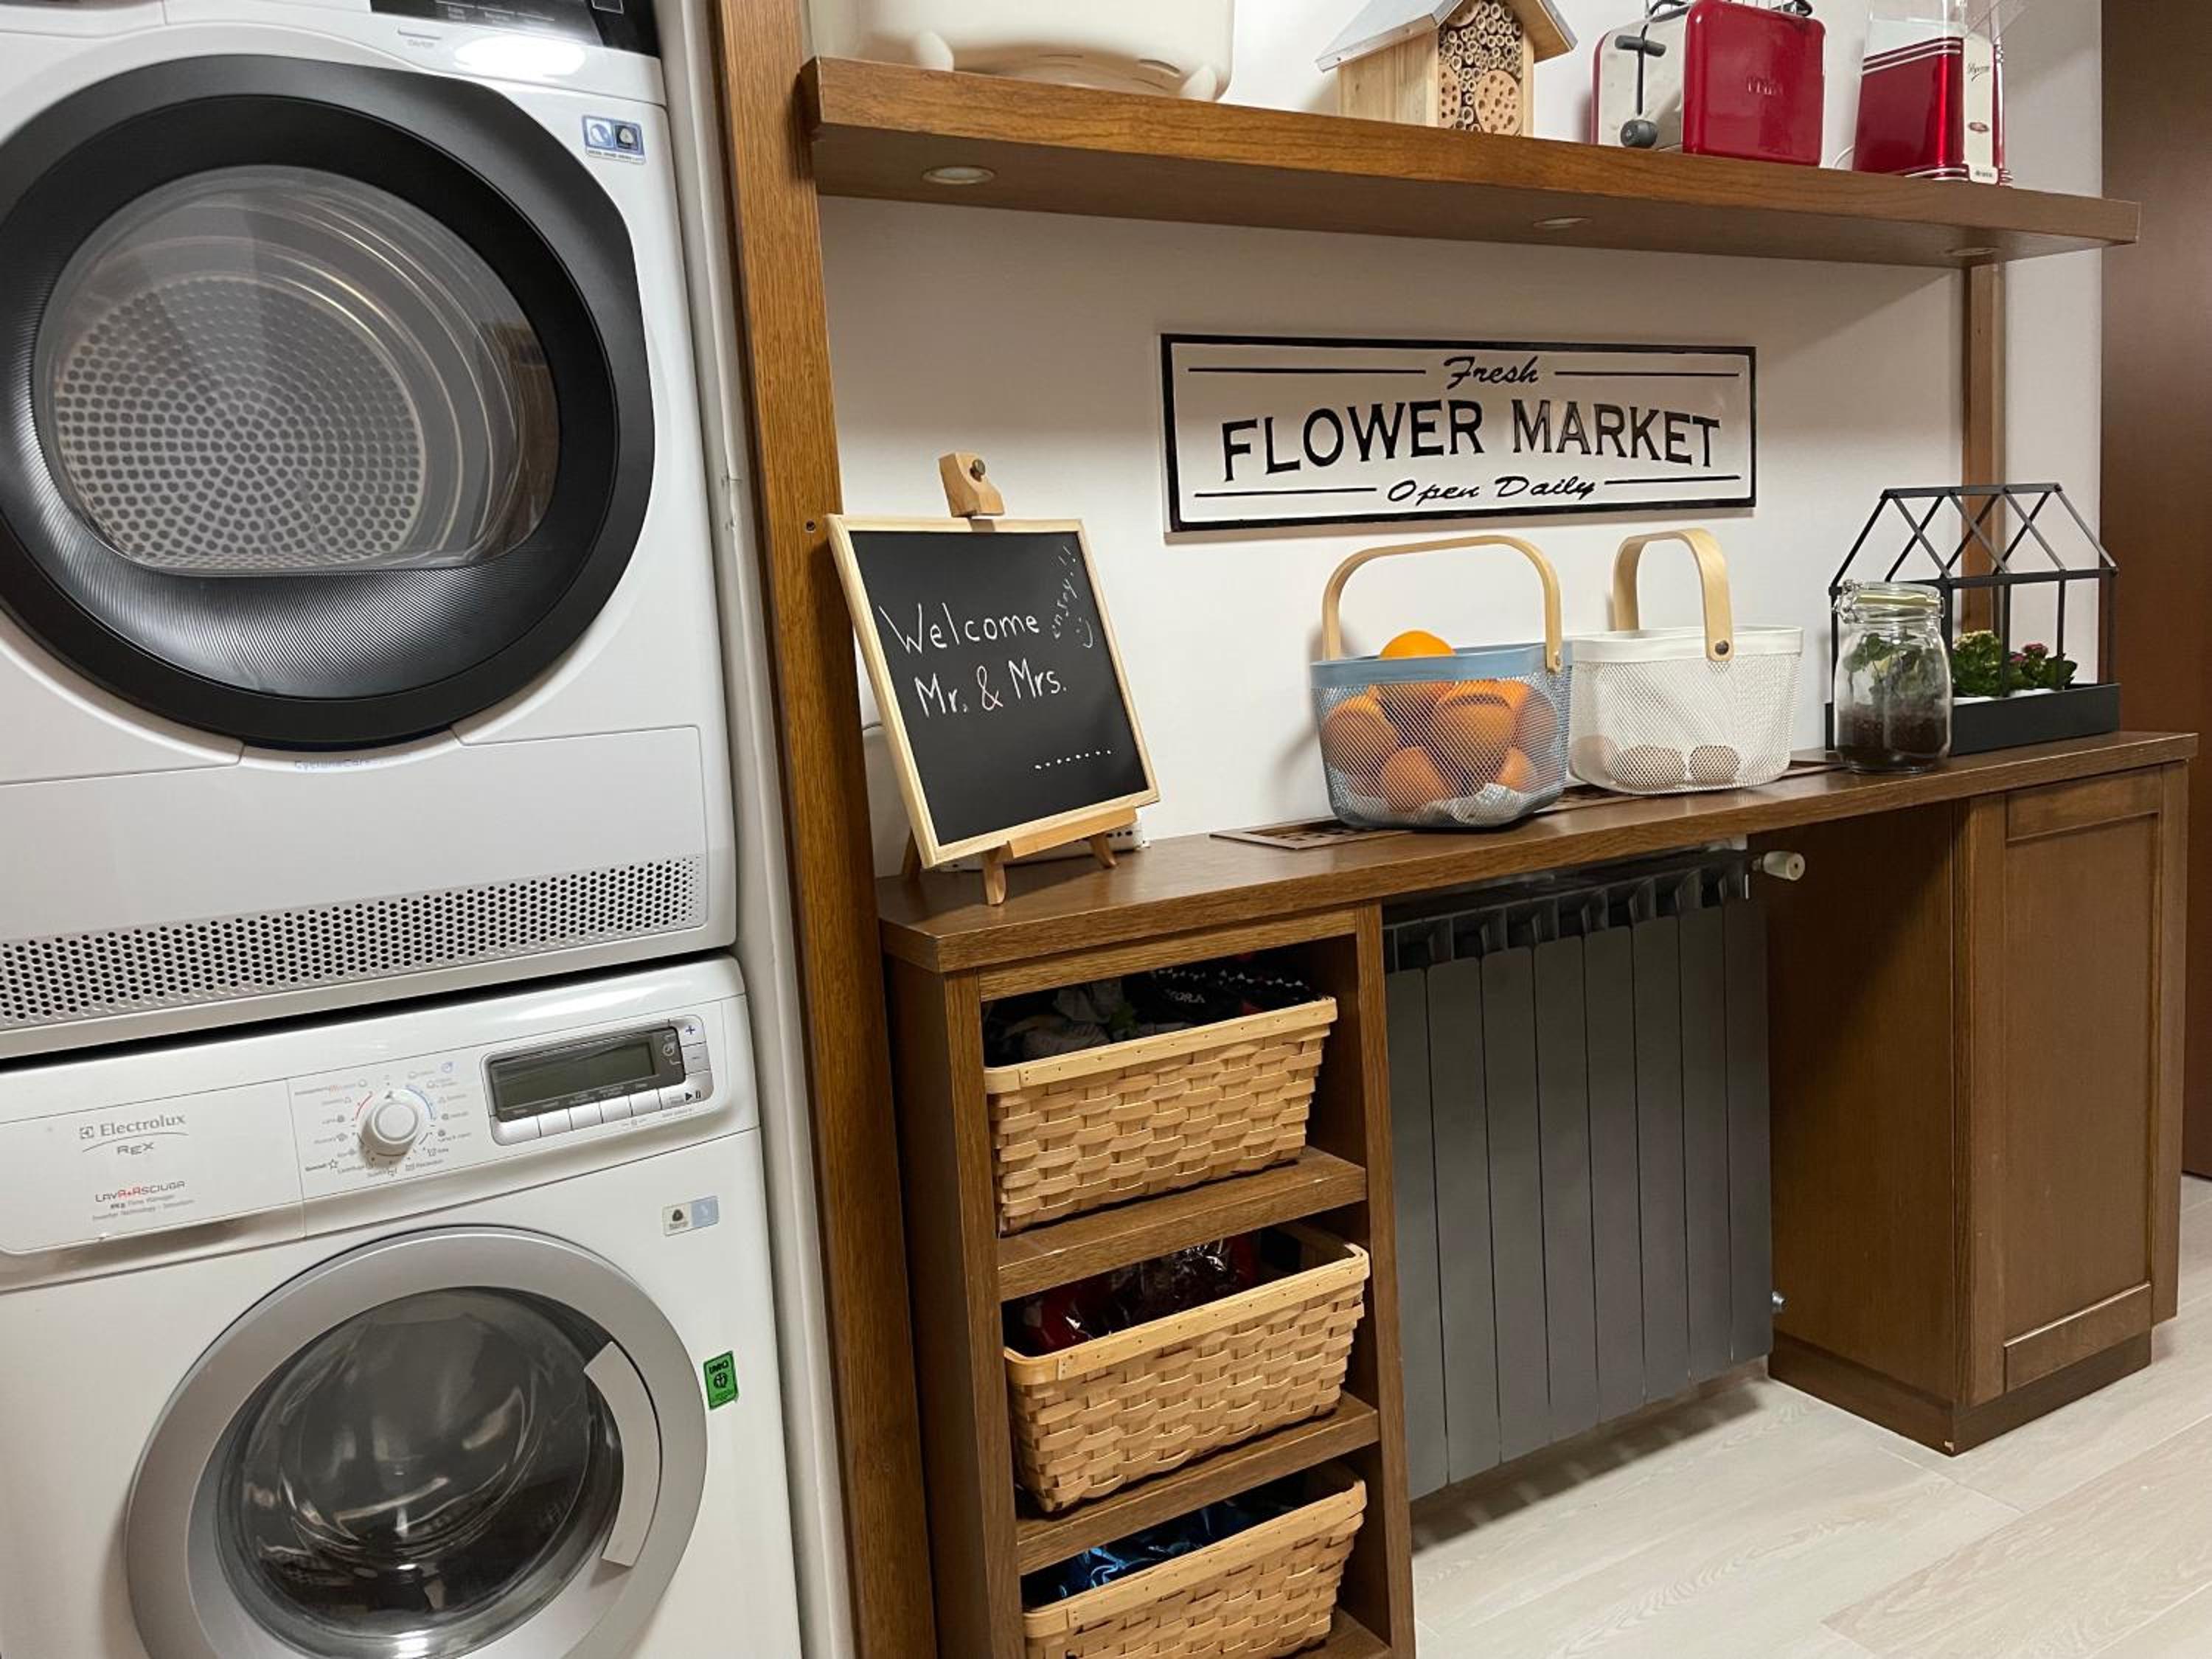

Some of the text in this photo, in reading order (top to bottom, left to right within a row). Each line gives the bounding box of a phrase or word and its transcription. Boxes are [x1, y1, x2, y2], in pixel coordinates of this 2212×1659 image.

[1443, 355, 1539, 389] Fresh
[1222, 398, 1720, 482] FLOWER MARKET
[1388, 474, 1595, 506] Open Daily
[877, 602, 1040, 654] Welcome
[914, 658, 1067, 717] Mr. & Mrs.
[100, 1114, 187, 1137] Electrolux
[116, 1141, 154, 1155] REX
